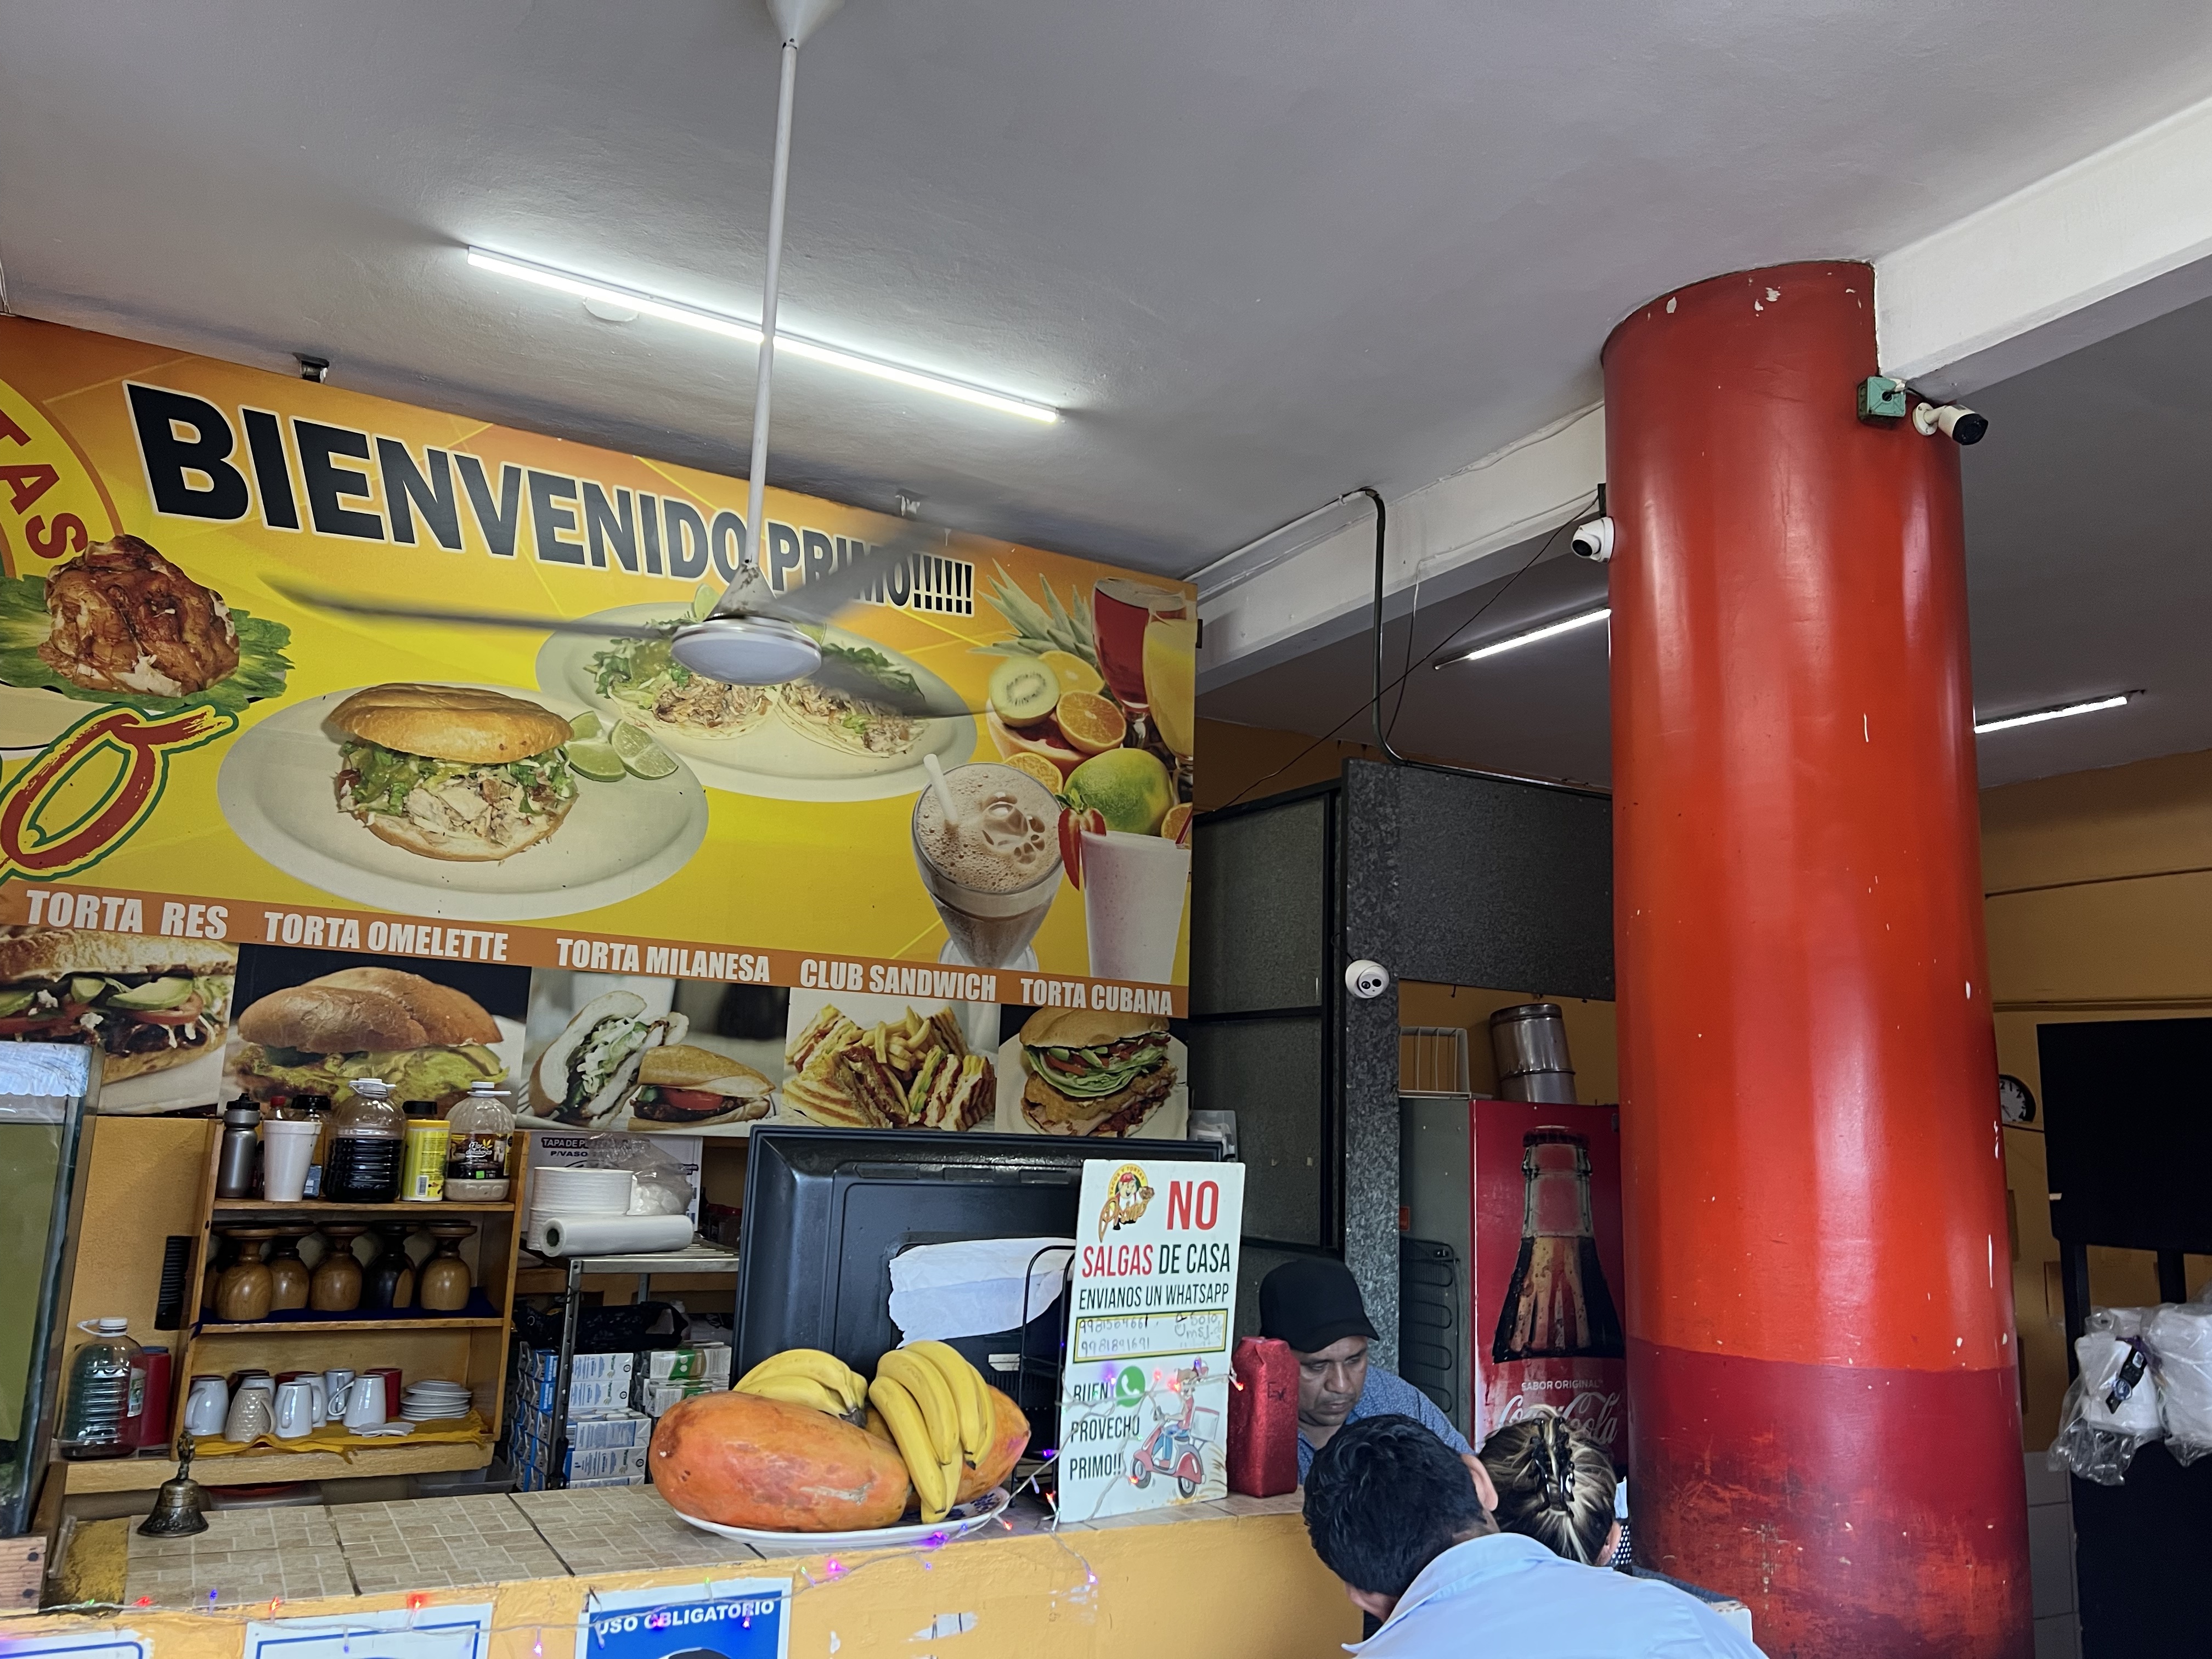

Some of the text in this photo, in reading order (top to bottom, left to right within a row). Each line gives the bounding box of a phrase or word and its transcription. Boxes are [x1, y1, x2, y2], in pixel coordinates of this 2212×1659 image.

[123, 380, 748, 585] BIENVENIDO
[27, 890, 229, 939] TORTA RES
[264, 911, 509, 962] TORTA OMELETTE
[556, 938, 770, 983] TORTA MILANESA
[800, 958, 997, 1002] CLUB SANDWICH
[1020, 978, 1173, 1017] TORTA CUBANA
[543, 1138, 565, 1147] TAPA
[566, 1139, 578, 1148] DE
[1167, 1181, 1219, 1231] NO
[1082, 1243, 1231, 1278] SALGAS DE CASA
[1079, 1283, 1229, 1310] ENVIANOS UN WHATSAPP
[1074, 1381, 1109, 1402] BUEN
[1521, 1380, 1600, 1391] SABOR ORIGINAL
[1070, 1416, 1140, 1443] PROVECHO
[1070, 1453, 1121, 1481] PRIMO!!
[598, 1600, 775, 1635] USO OBLIGATORIO
